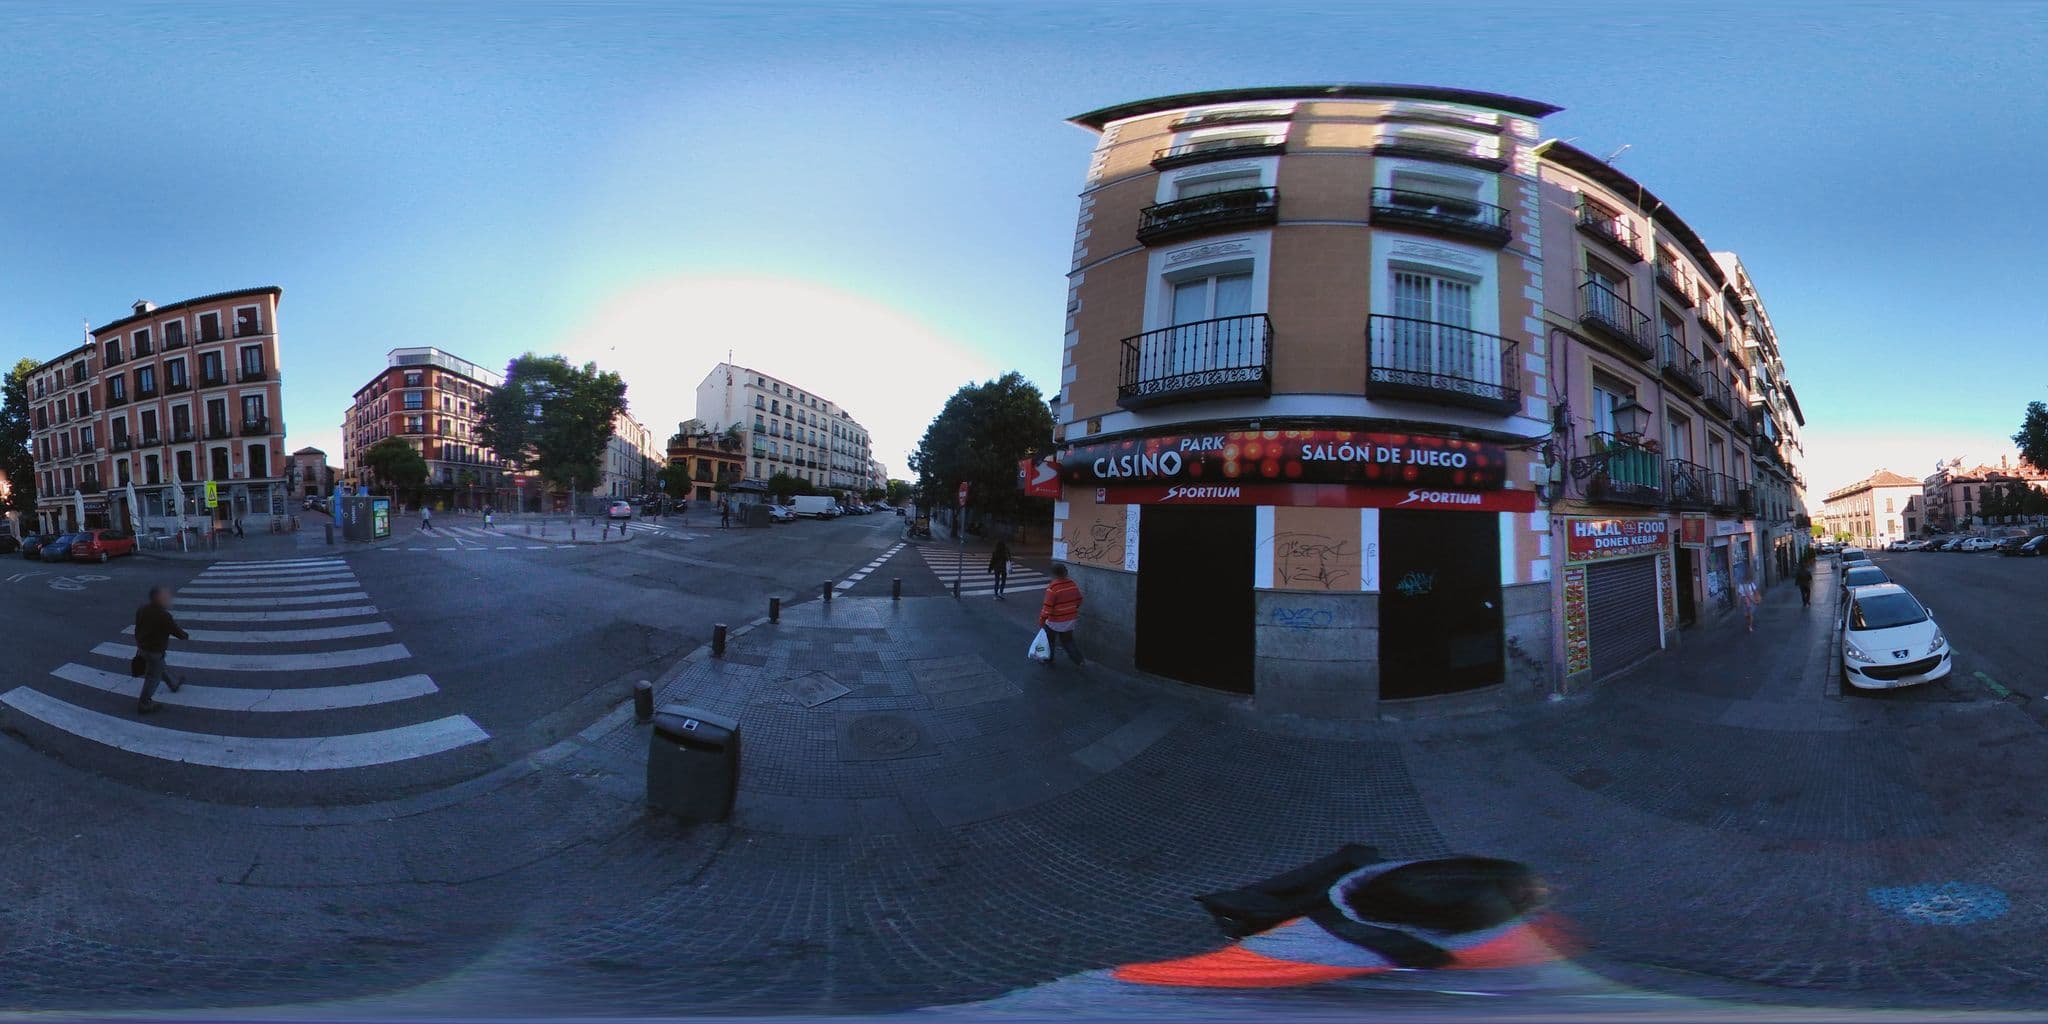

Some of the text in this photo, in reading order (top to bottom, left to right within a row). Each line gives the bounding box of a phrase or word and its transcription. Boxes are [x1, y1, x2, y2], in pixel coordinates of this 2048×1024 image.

[1093, 436, 1225, 478] CASINO PARK
[1302, 441, 1467, 468] SALÓN DE JUEGO
[1159, 485, 1240, 501] SPORTIUM
[1397, 488, 1481, 505] SPORTIUM
[1575, 521, 1665, 537] HALAL FOOD
[1595, 535, 1658, 549] DONER KEBAP
